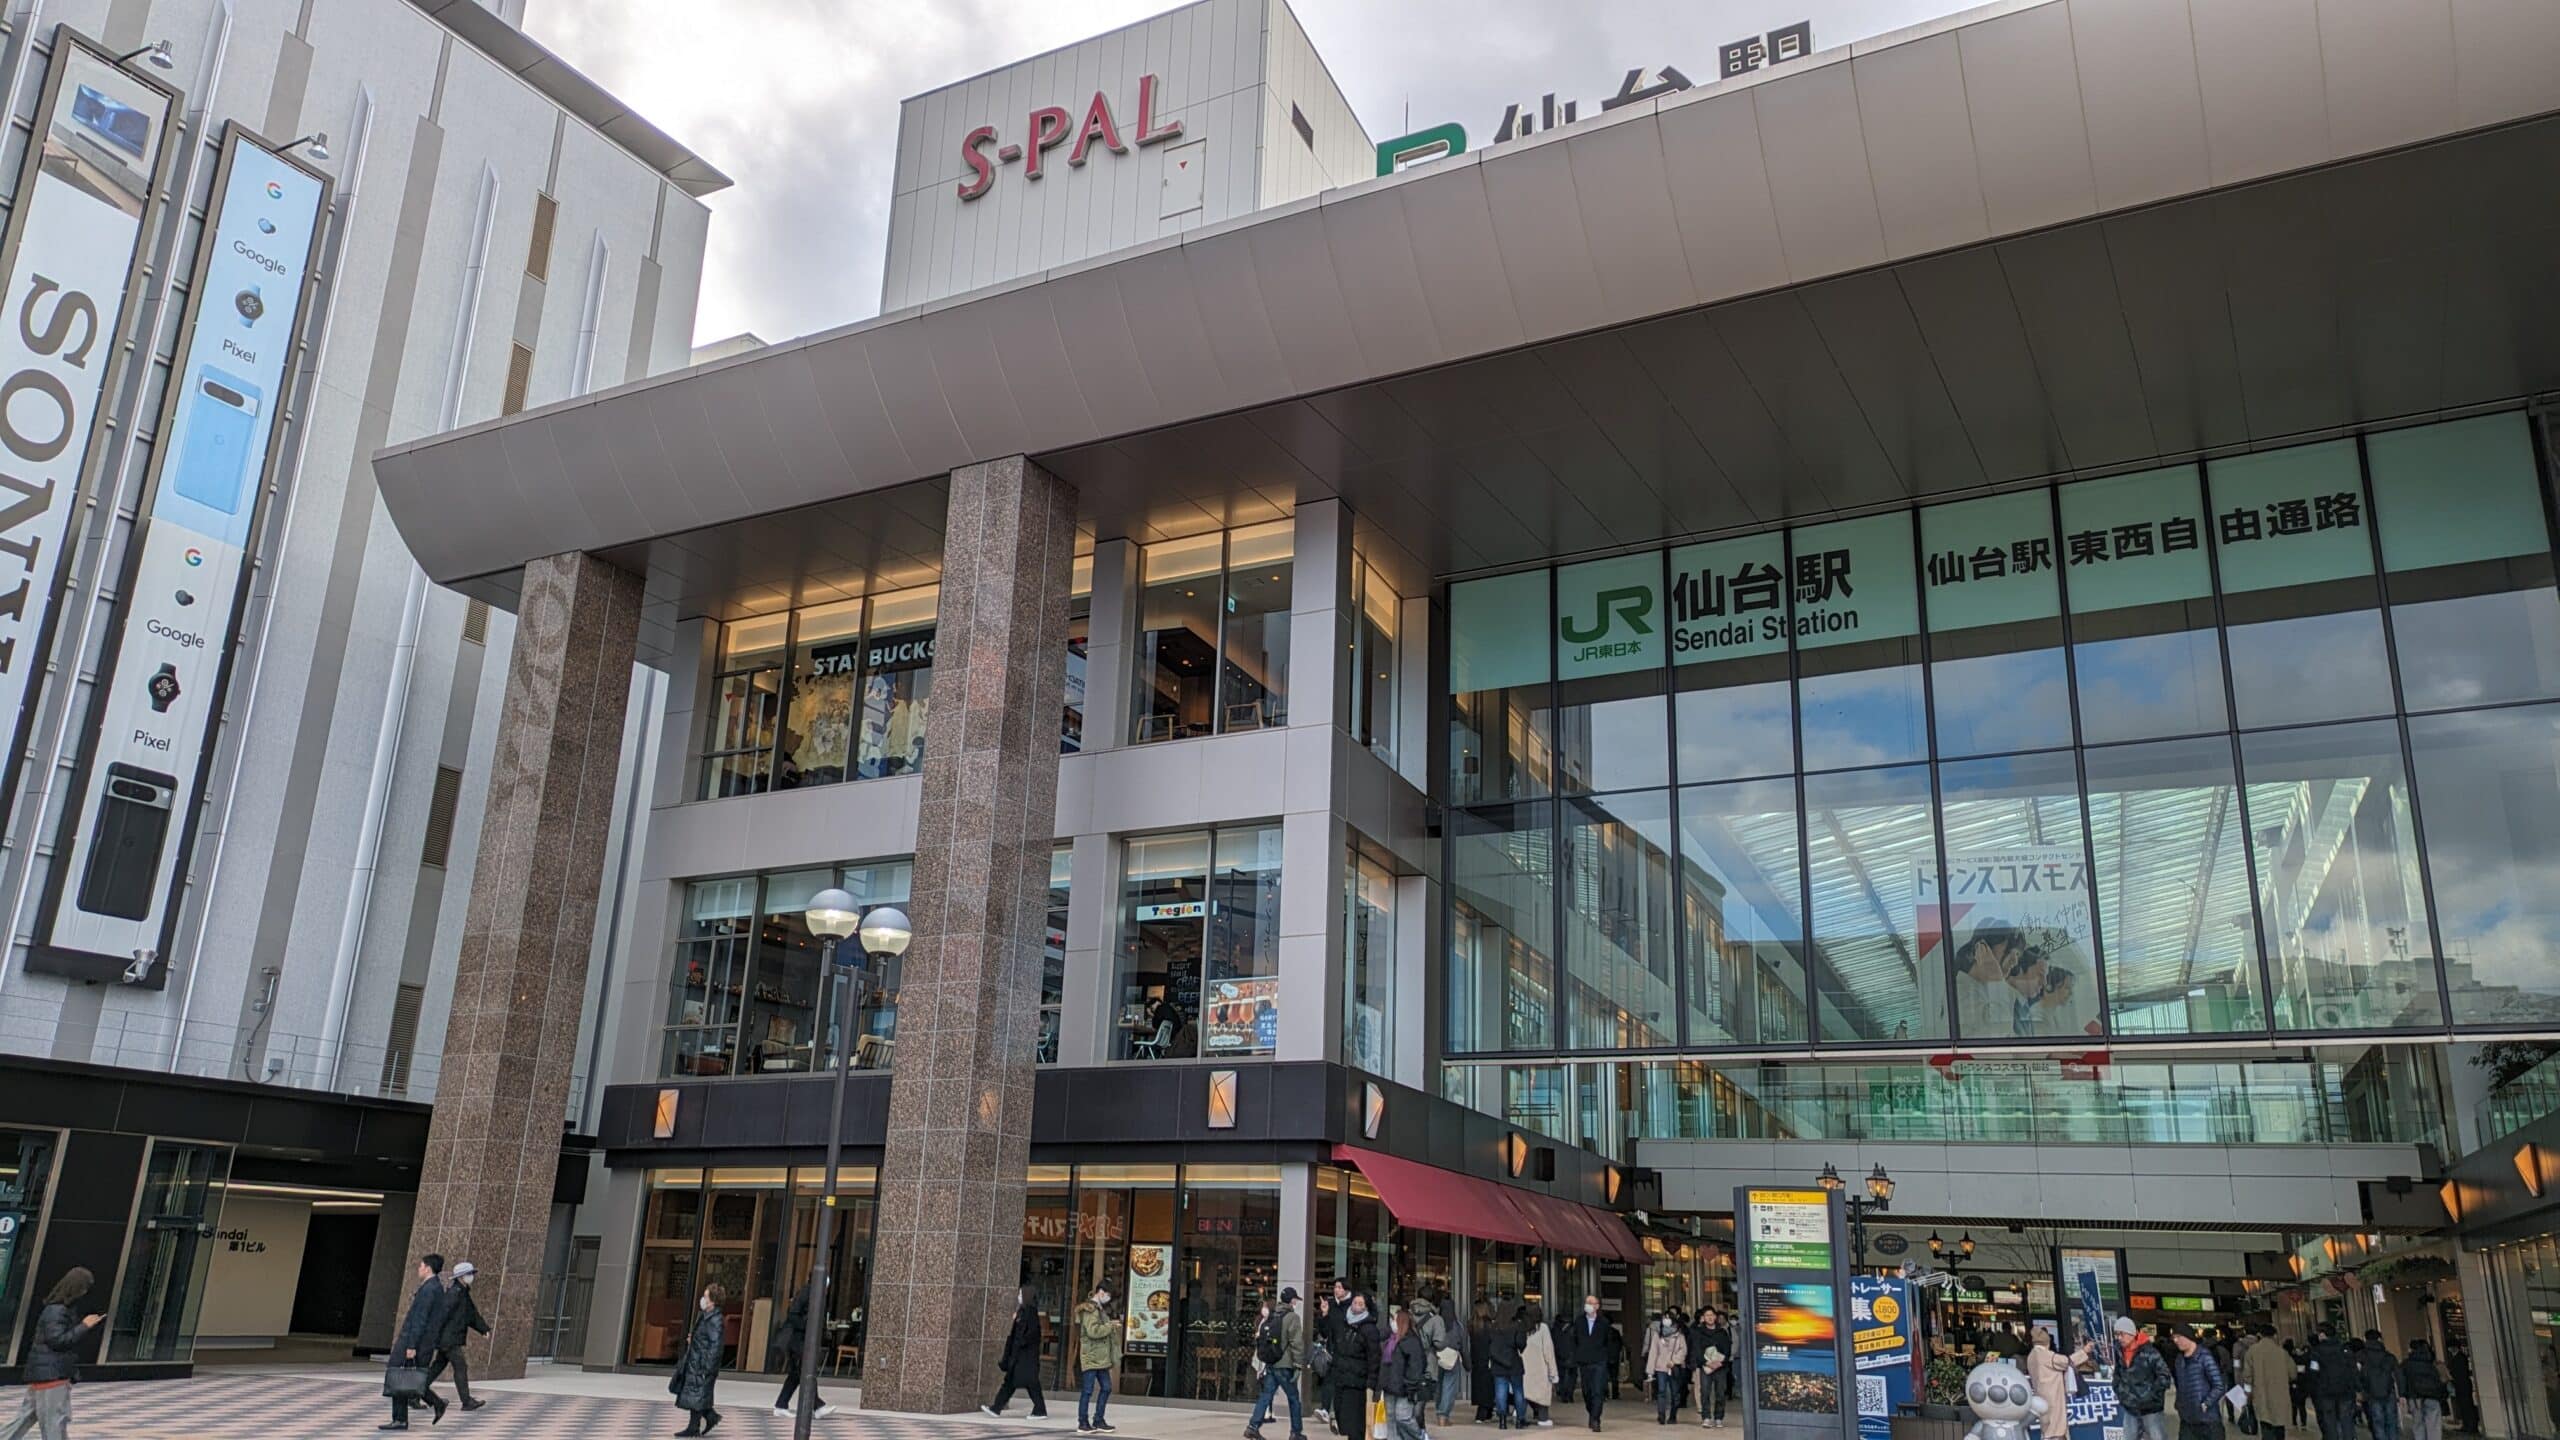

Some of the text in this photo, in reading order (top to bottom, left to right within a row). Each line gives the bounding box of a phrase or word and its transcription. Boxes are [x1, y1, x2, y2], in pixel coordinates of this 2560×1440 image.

[957, 73, 1184, 200] S-PAL
[233, 239, 287, 276] Google
[222, 337, 257, 365] Pixel
[1673, 549, 1854, 622] 仙台駅
[1561, 585, 1655, 643] JR
[1674, 608, 1859, 652] Sendai Station
[146, 618, 206, 650] Google
[1573, 640, 1642, 662] JR東日本
[813, 639, 936, 676] STABUCKS
[132, 729, 171, 754] Pixel
